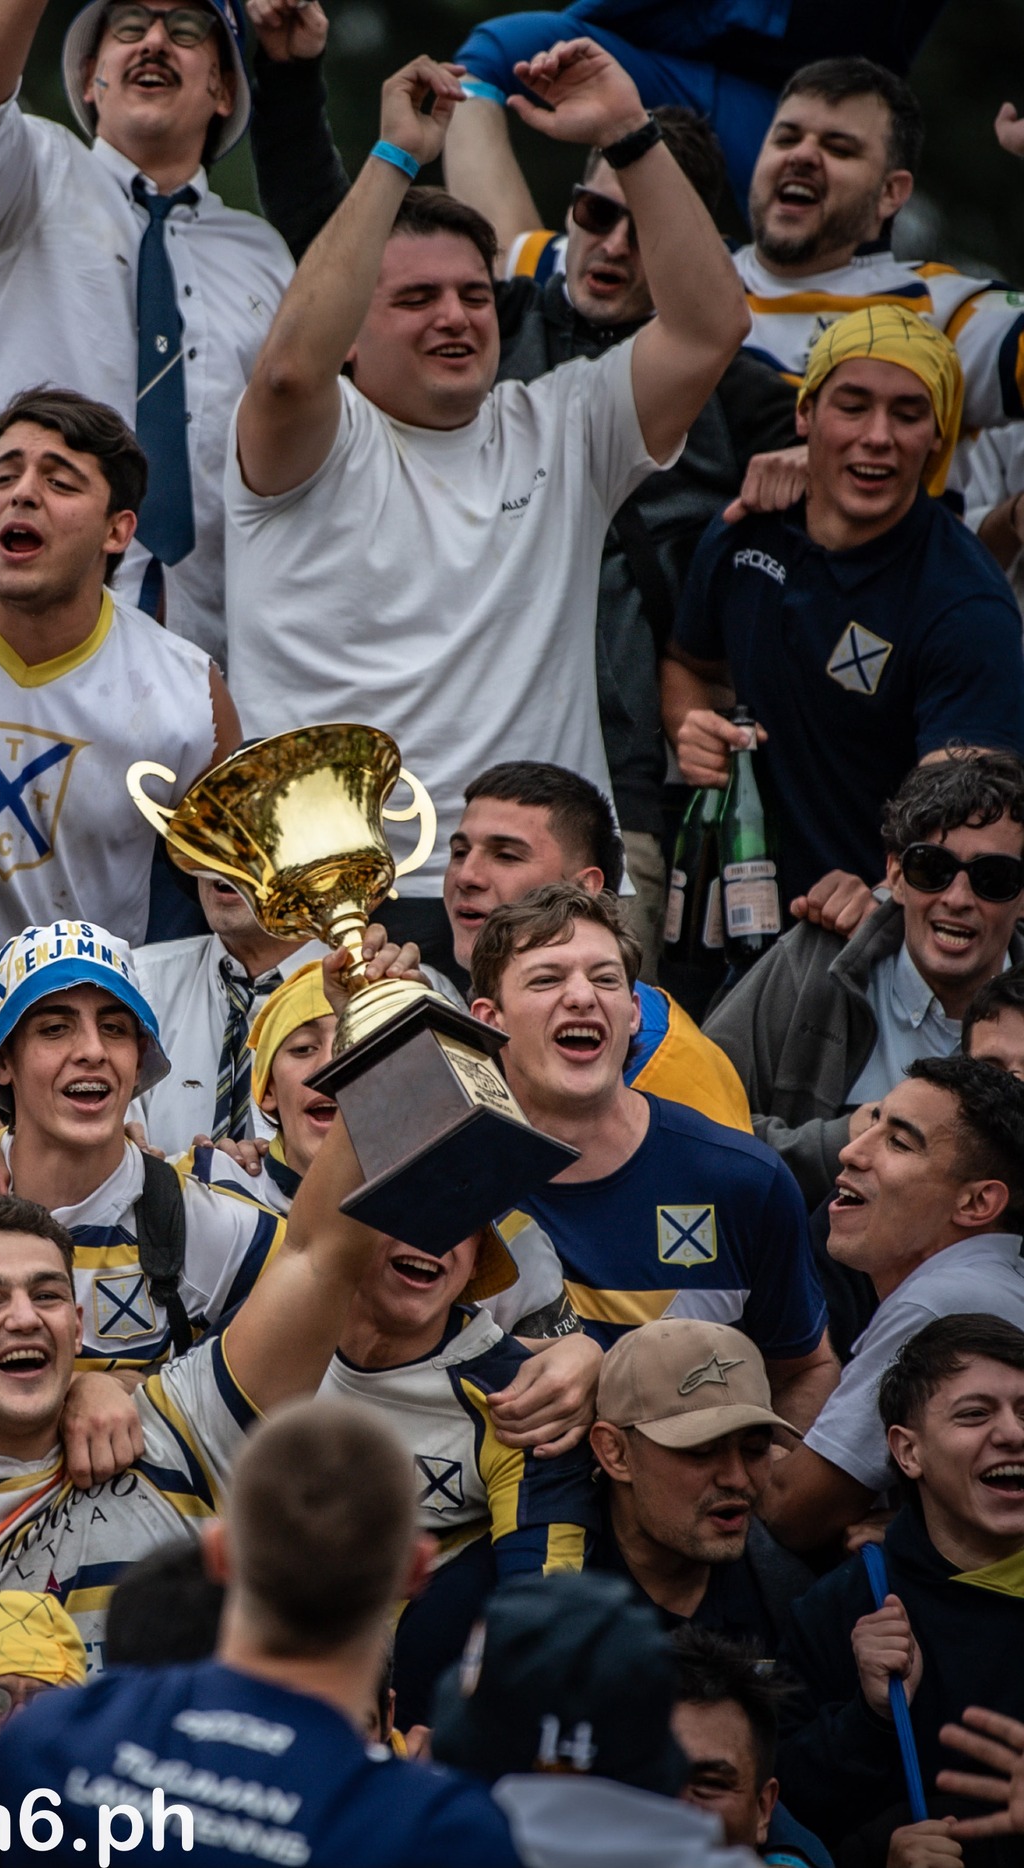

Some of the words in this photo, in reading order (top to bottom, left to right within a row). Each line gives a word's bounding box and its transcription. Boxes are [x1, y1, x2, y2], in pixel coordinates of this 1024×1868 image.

[5, 737, 25, 762] T
[32, 788, 50, 813] T
[54, 922, 95, 939] LOS
[14, 939, 129, 983] BENJAMINES
